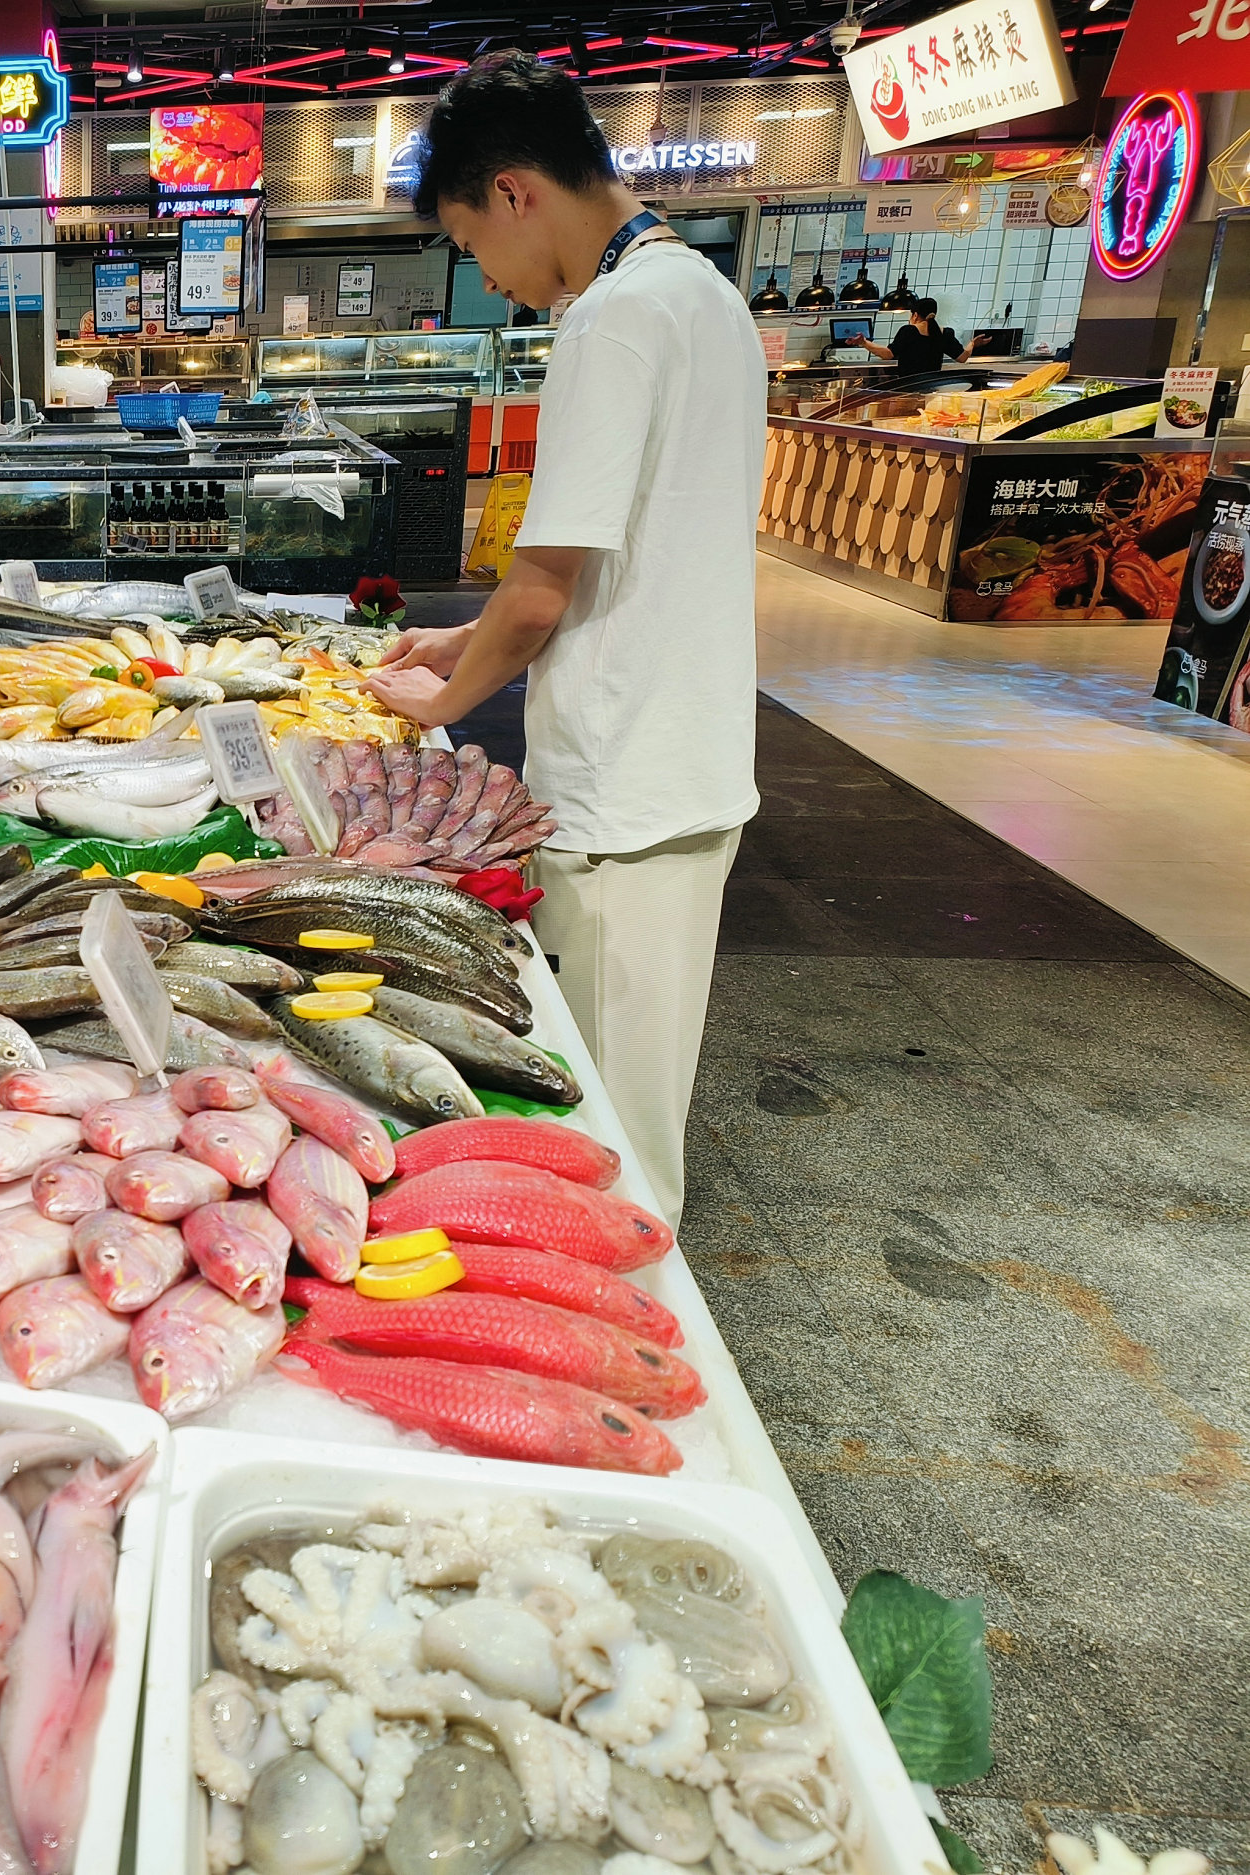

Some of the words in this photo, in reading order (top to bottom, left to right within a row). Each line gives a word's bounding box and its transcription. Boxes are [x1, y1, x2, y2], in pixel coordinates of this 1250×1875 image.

[922, 107, 947, 127] DONG
[949, 100, 975, 120] DONG
[977, 95, 993, 112] MA
[997, 90, 1008, 108] LA
[1010, 80, 1039, 103] TANG
[180, 181, 211, 192] lobster
[877, 206, 912, 218] 取餐口
[993, 478, 1079, 500] 海鲜大咖
[990, 503, 1041, 516] 搭配丰富
[1043, 502, 1106, 515] 一次大满足
[1208, 531, 1246, 555] 活捞现蒸
[993, 581, 1013, 592] 盒马
